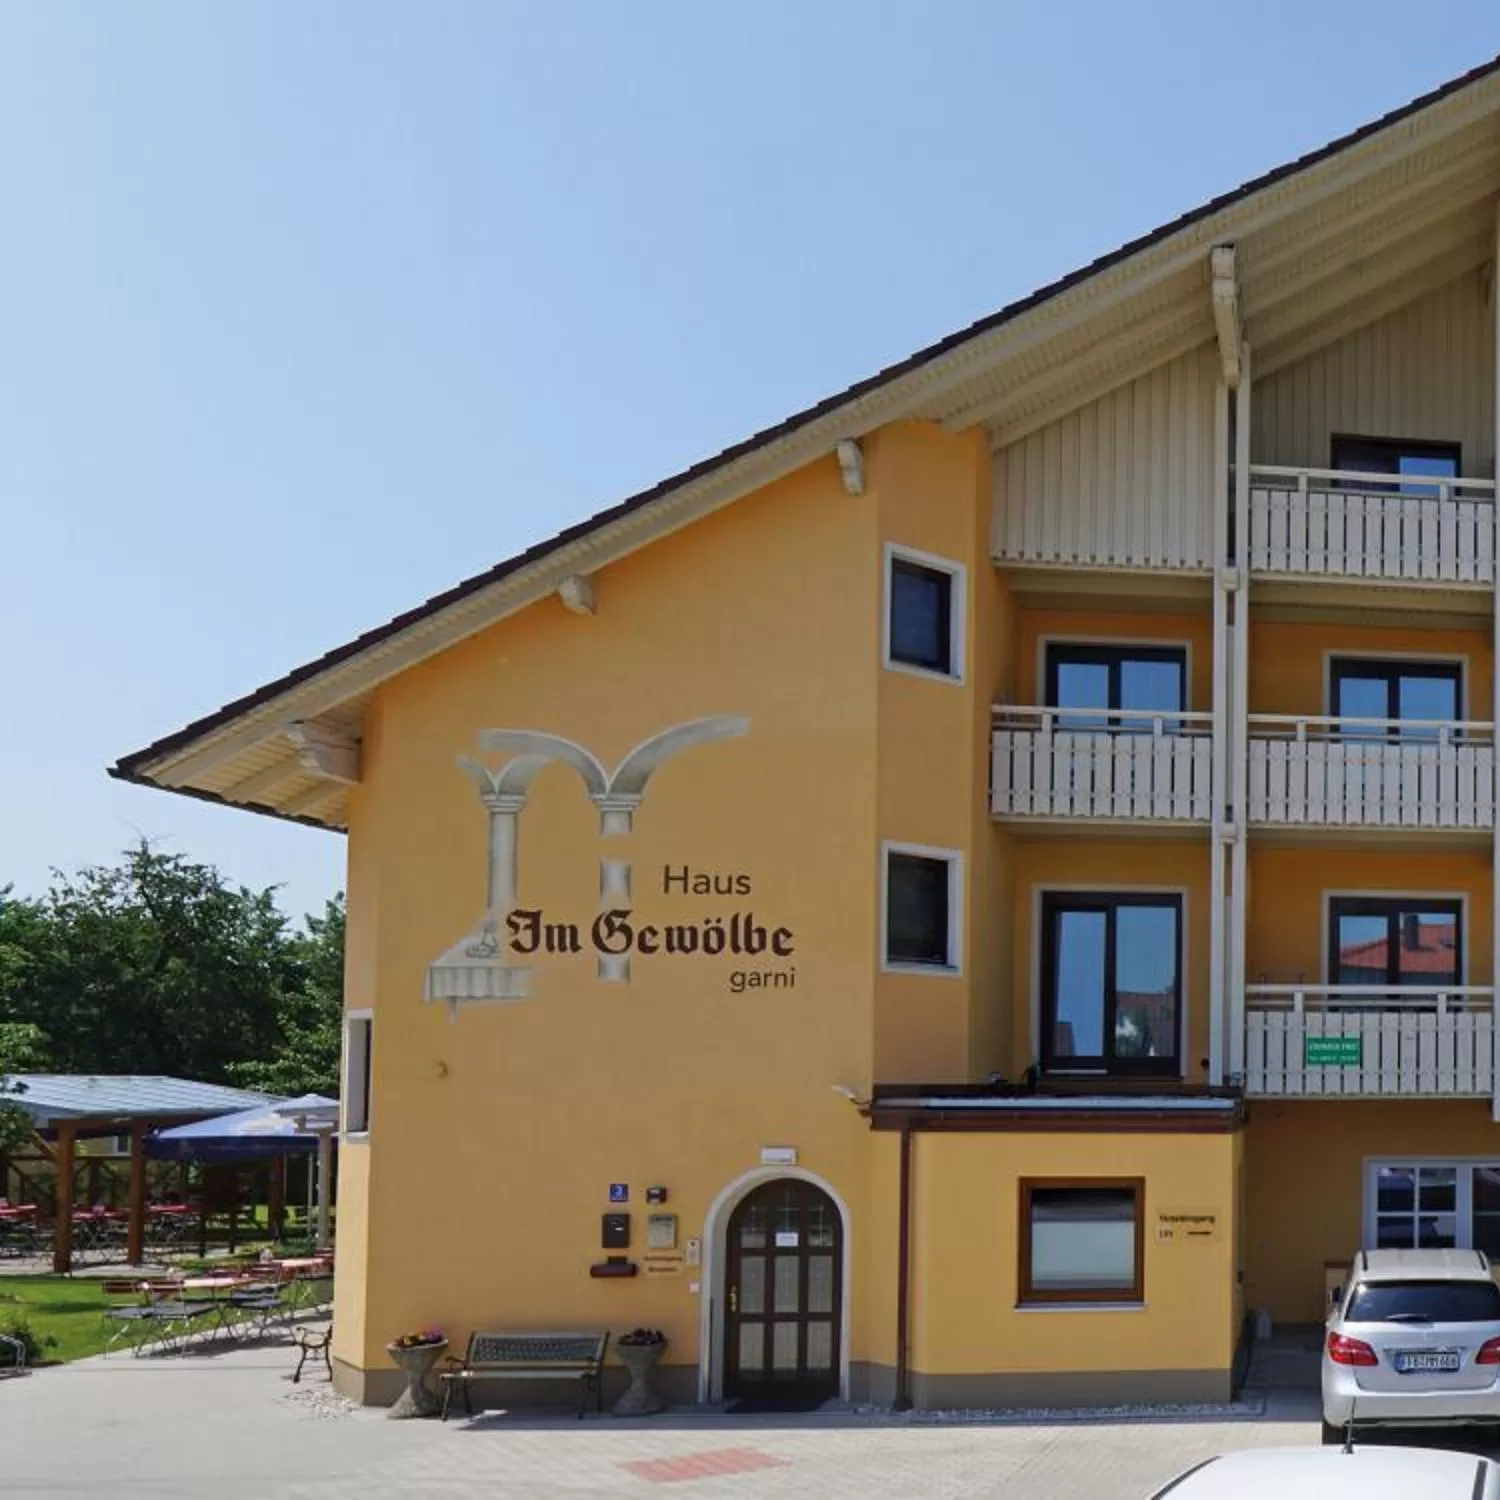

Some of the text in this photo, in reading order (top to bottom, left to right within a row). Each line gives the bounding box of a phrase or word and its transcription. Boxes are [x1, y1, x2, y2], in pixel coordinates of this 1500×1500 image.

[663, 864, 751, 895] Haus
[505, 908, 795, 956] Im Gewölbe
[729, 967, 796, 993] garni
